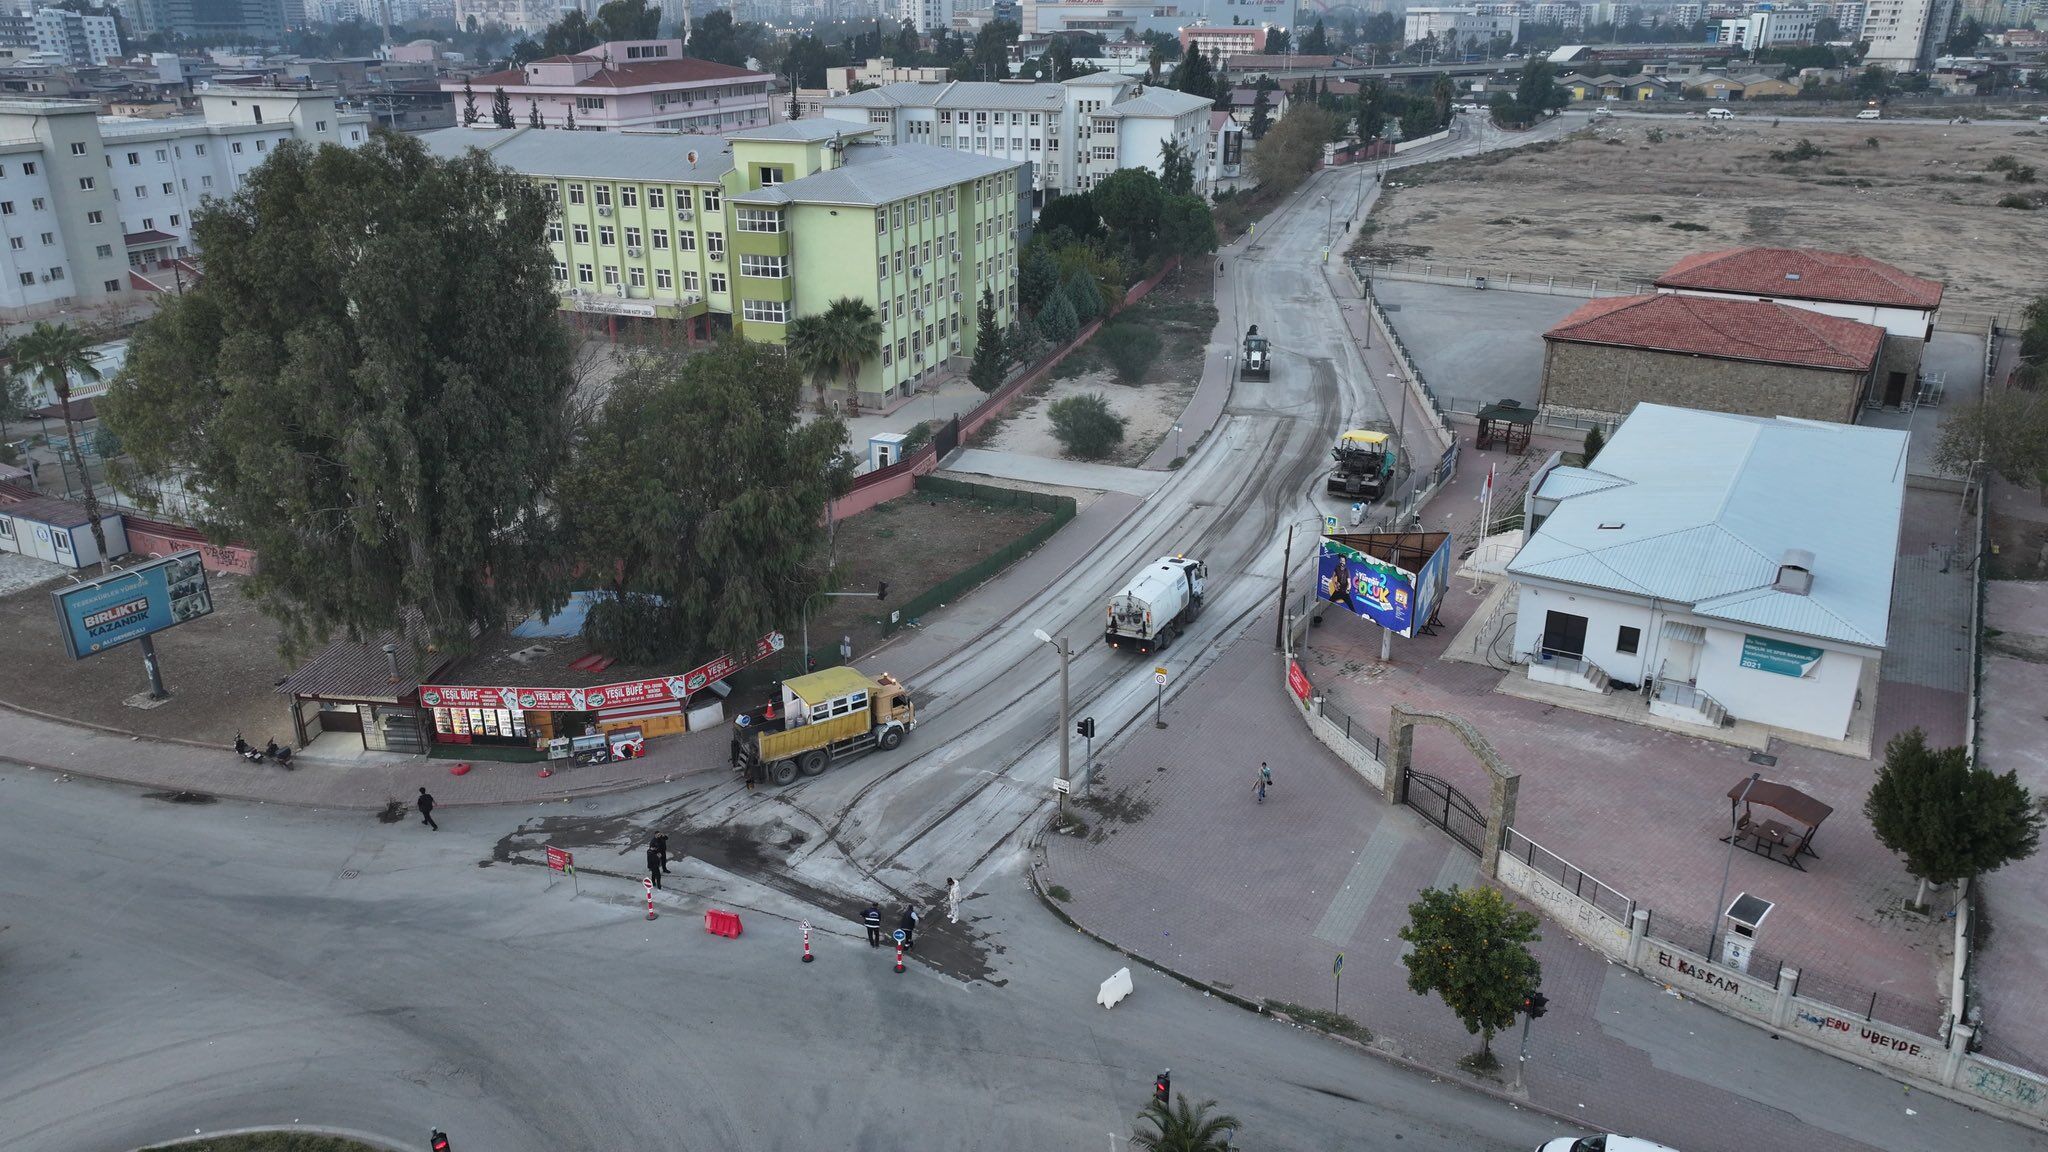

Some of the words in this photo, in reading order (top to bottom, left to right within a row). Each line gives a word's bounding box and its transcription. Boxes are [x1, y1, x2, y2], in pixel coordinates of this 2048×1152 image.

[1352, 575, 1391, 603] ÇOCUK
[89, 612, 149, 638] KAZANDIK
[1742, 660, 1761, 669] 2021
[441, 690, 460, 702] YEŞİL
[461, 689, 478, 700] BÜFE
[605, 687, 625, 700] YEŞİL
[626, 683, 643, 696] BÜFE
[1659, 951, 1675, 970] EL
[1826, 1017, 1850, 1031] EBU
